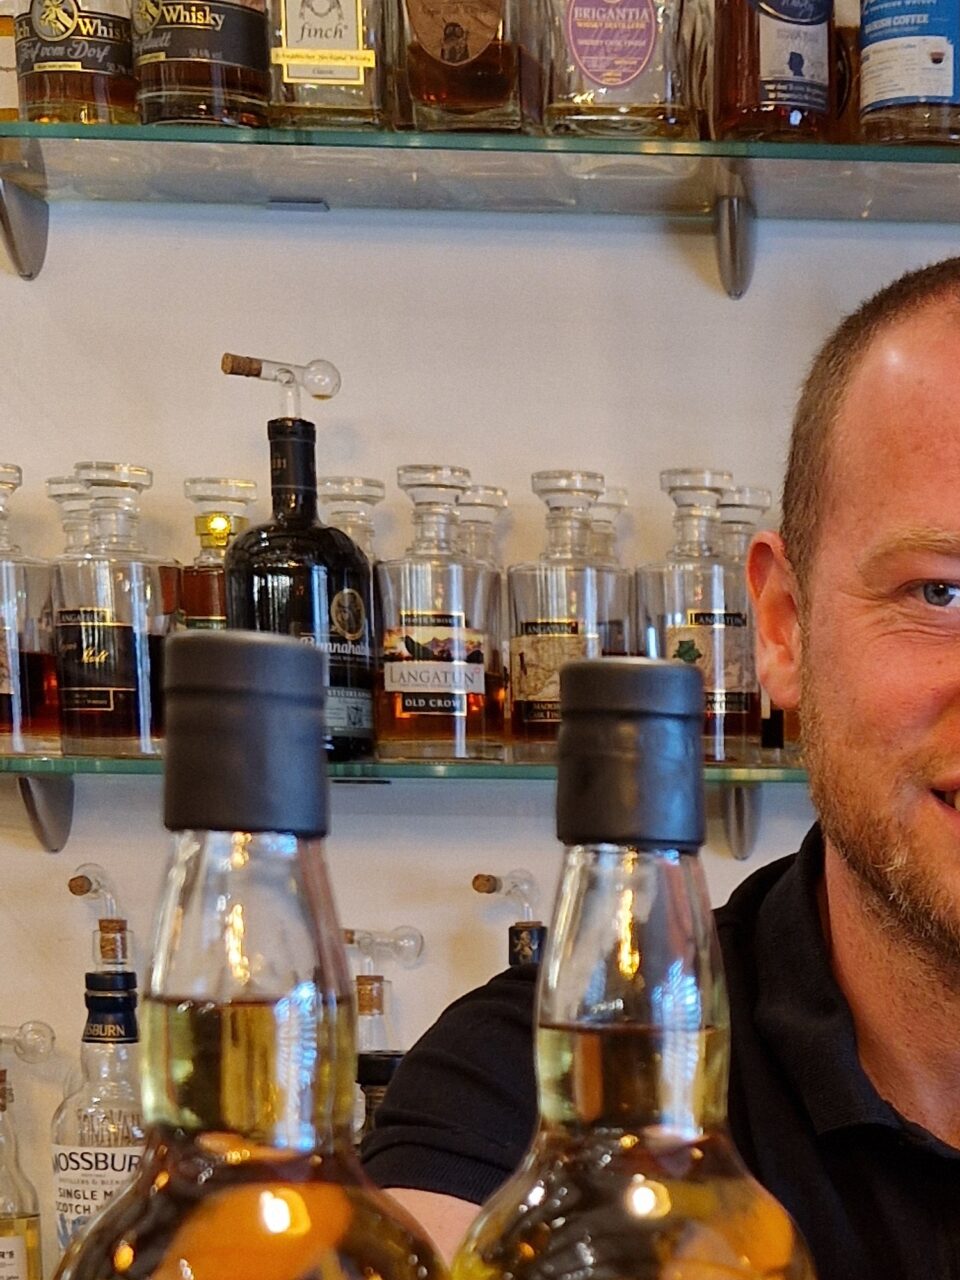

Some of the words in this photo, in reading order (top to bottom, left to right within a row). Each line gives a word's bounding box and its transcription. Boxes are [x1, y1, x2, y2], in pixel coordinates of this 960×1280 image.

[162, 5, 225, 31] Whisky
[574, 7, 649, 21] BRIGANTIA
[296, 22, 343, 43] finch
[67, 40, 111, 62] Dorf
[389, 665, 475, 685] LANGATUN
[404, 698, 427, 708] OLD
[58, 1187, 97, 1201] SINGLE
